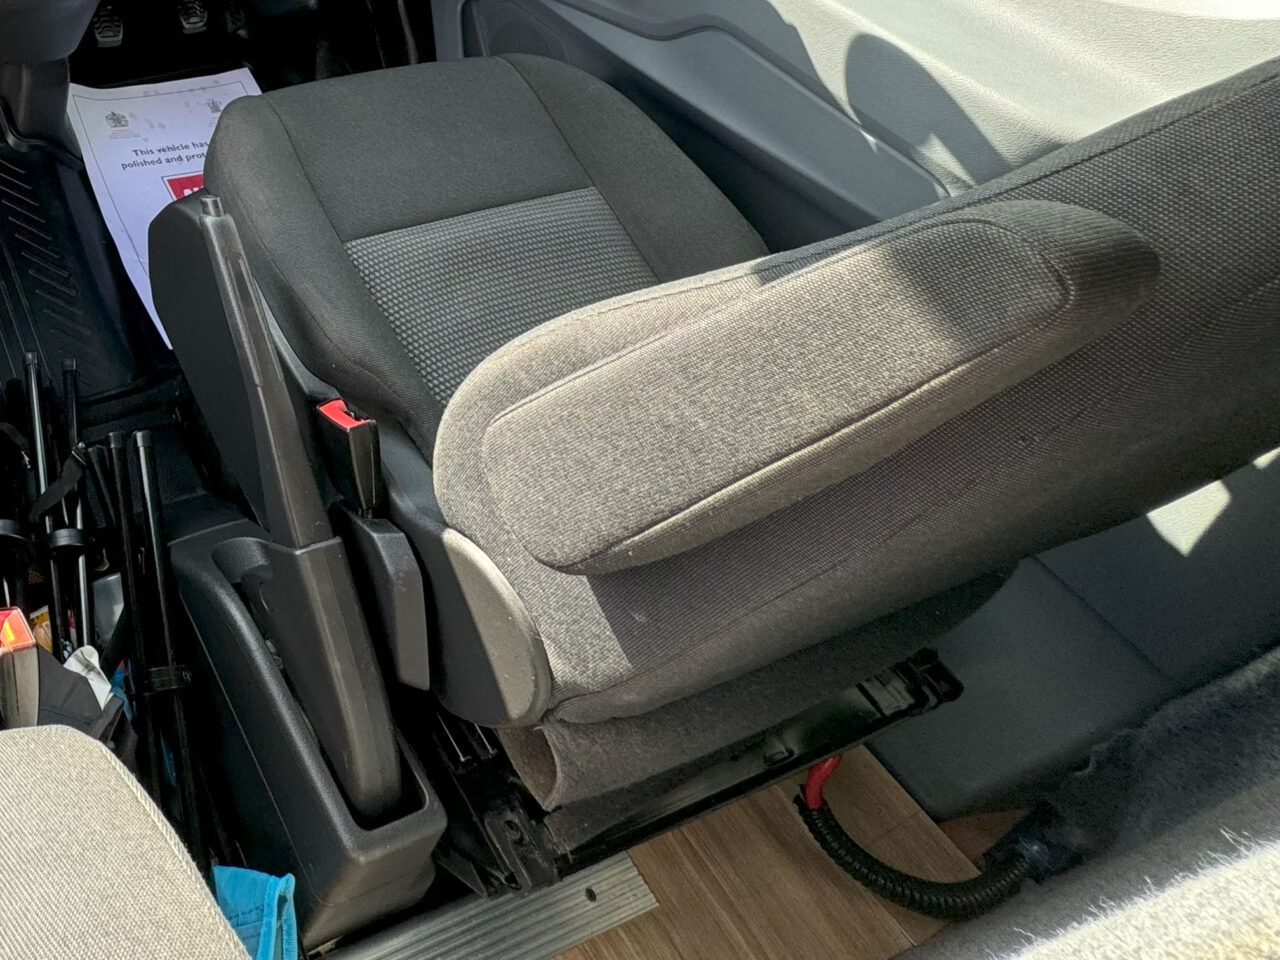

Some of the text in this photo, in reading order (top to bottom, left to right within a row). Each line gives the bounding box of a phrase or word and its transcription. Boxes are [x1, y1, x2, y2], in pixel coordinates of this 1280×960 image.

[131, 148, 154, 157] This
[157, 143, 190, 155] vehicle
[121, 152, 206, 170] polished and prot
